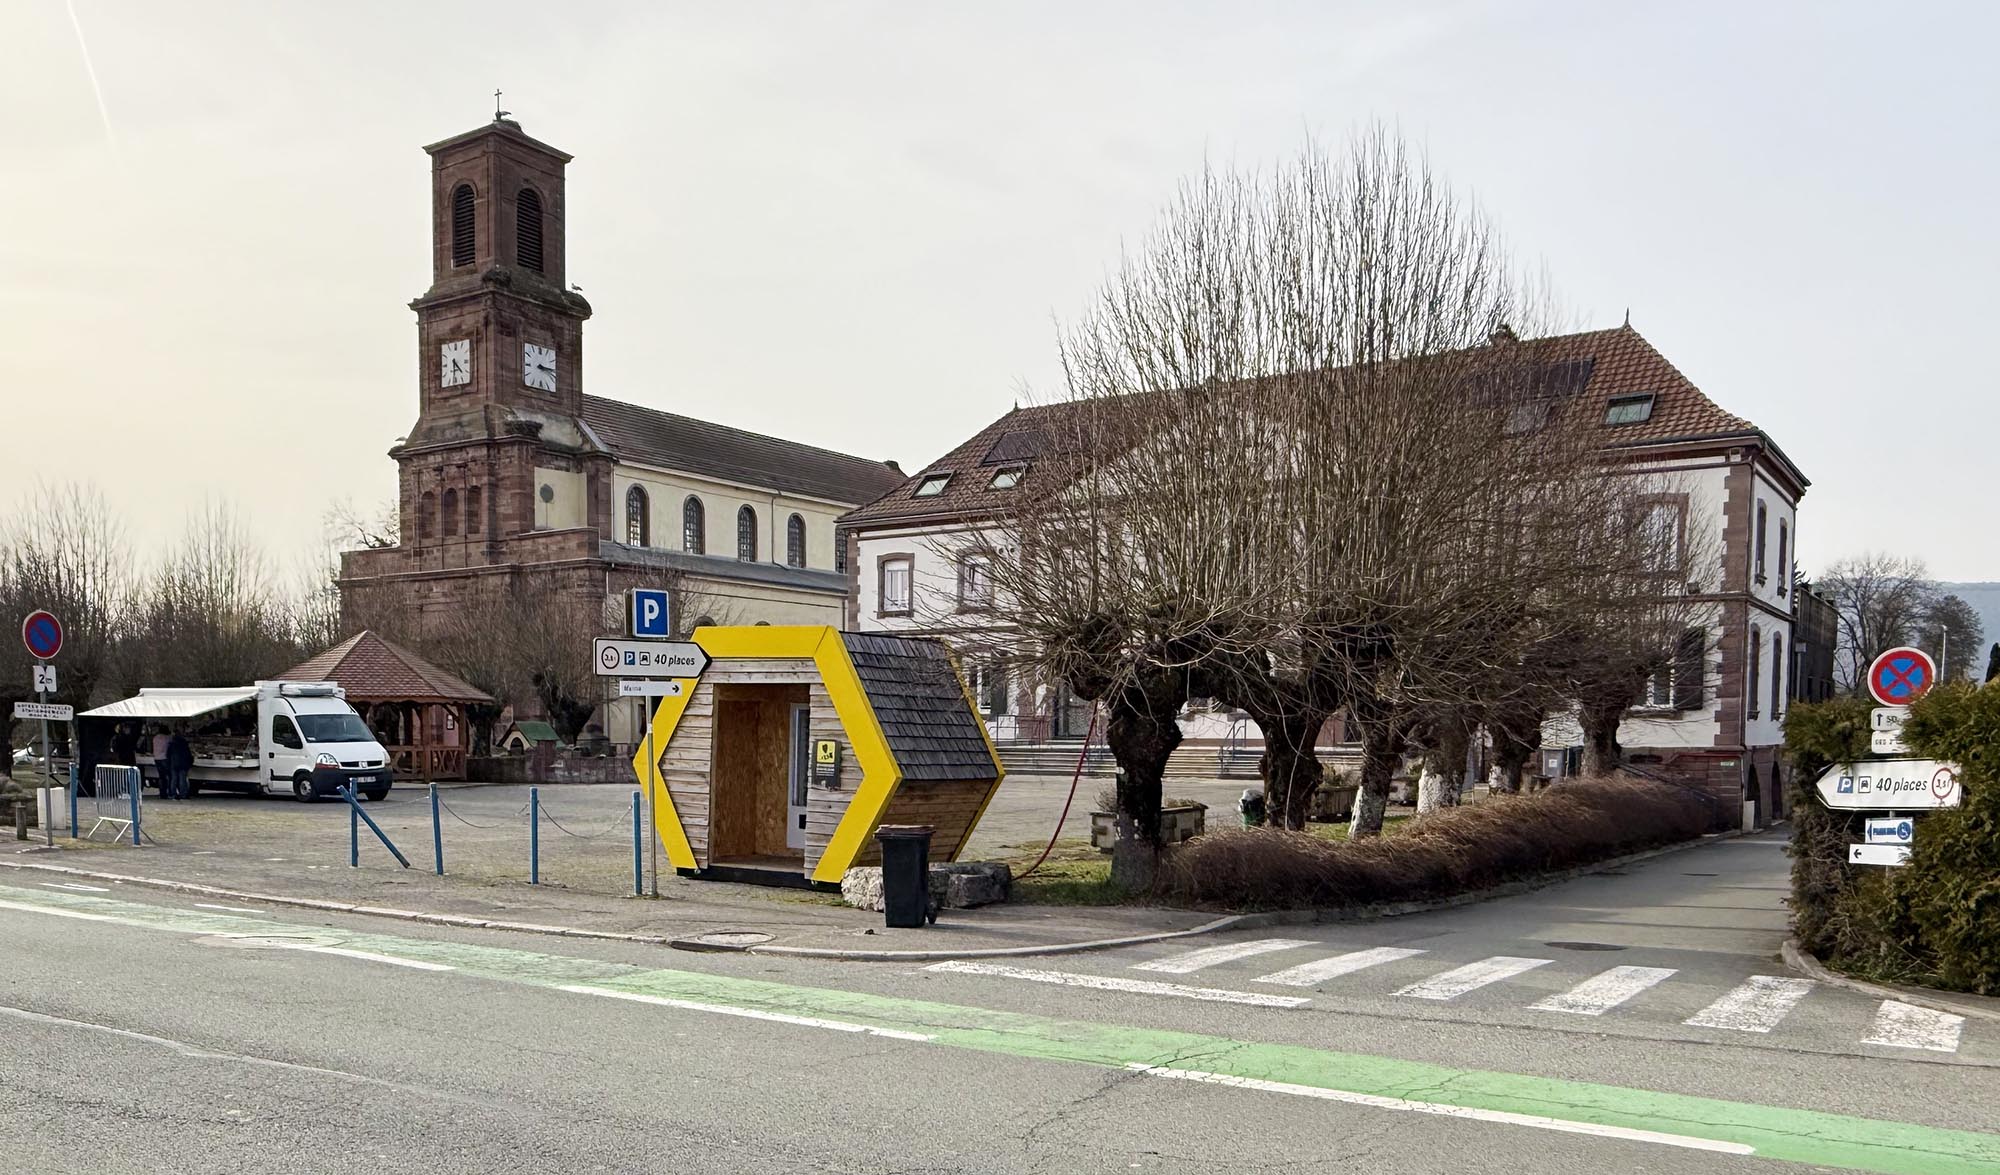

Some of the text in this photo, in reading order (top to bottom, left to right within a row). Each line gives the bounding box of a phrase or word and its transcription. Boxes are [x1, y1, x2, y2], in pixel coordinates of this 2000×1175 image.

[644, 598, 660, 628] P
[654, 654, 667, 665] 40
[668, 655, 696, 667] places
[1876, 777, 1892, 792] 40
[1893, 777, 1928, 795] places
